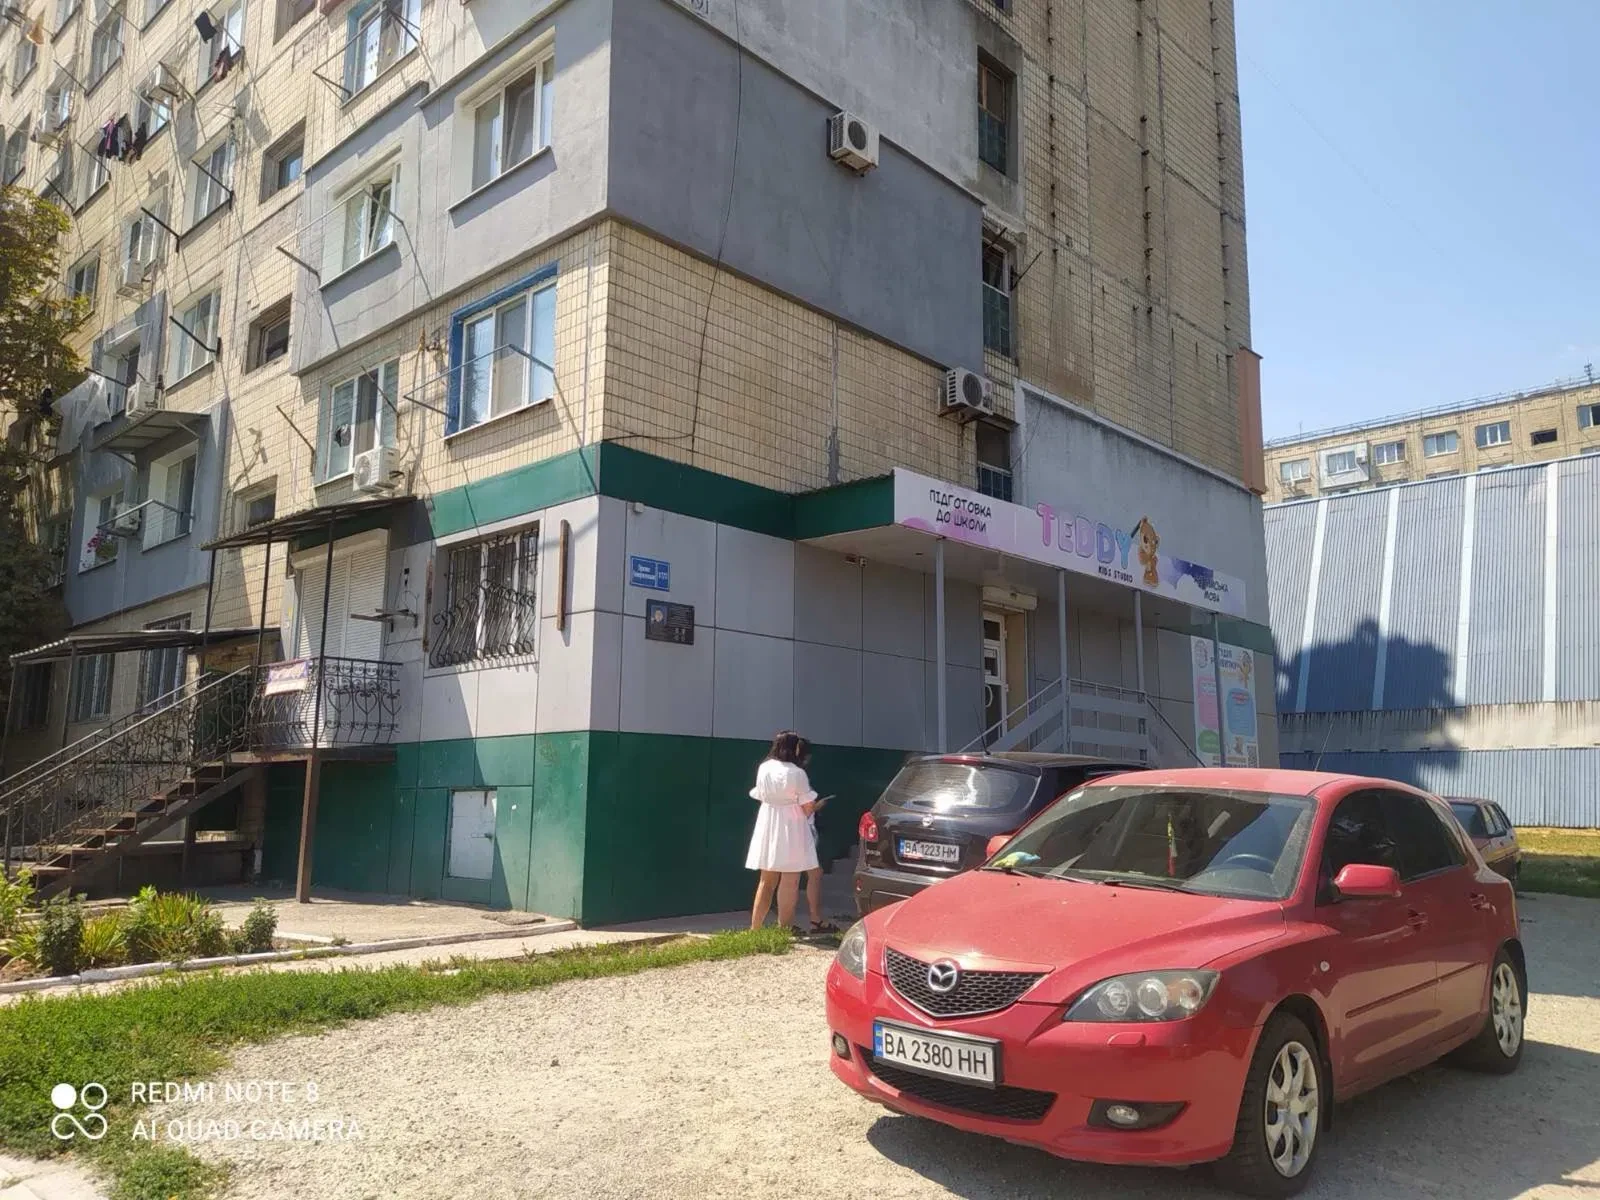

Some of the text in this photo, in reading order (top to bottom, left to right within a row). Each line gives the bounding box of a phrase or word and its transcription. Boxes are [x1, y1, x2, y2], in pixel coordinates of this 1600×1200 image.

[929, 489, 992, 518] ПІДГОТОВКА
[936, 509, 986, 533] ДО ШКОЛИ
[1036, 502, 1132, 569] TEDDY
[1098, 566, 1133, 584] KIDS STUDIO
[905, 842, 957, 859] BA 1223 HM
[884, 1032, 907, 1060] BA
[911, 1038, 953, 1068] 2380
[958, 1047, 988, 1075] HH
